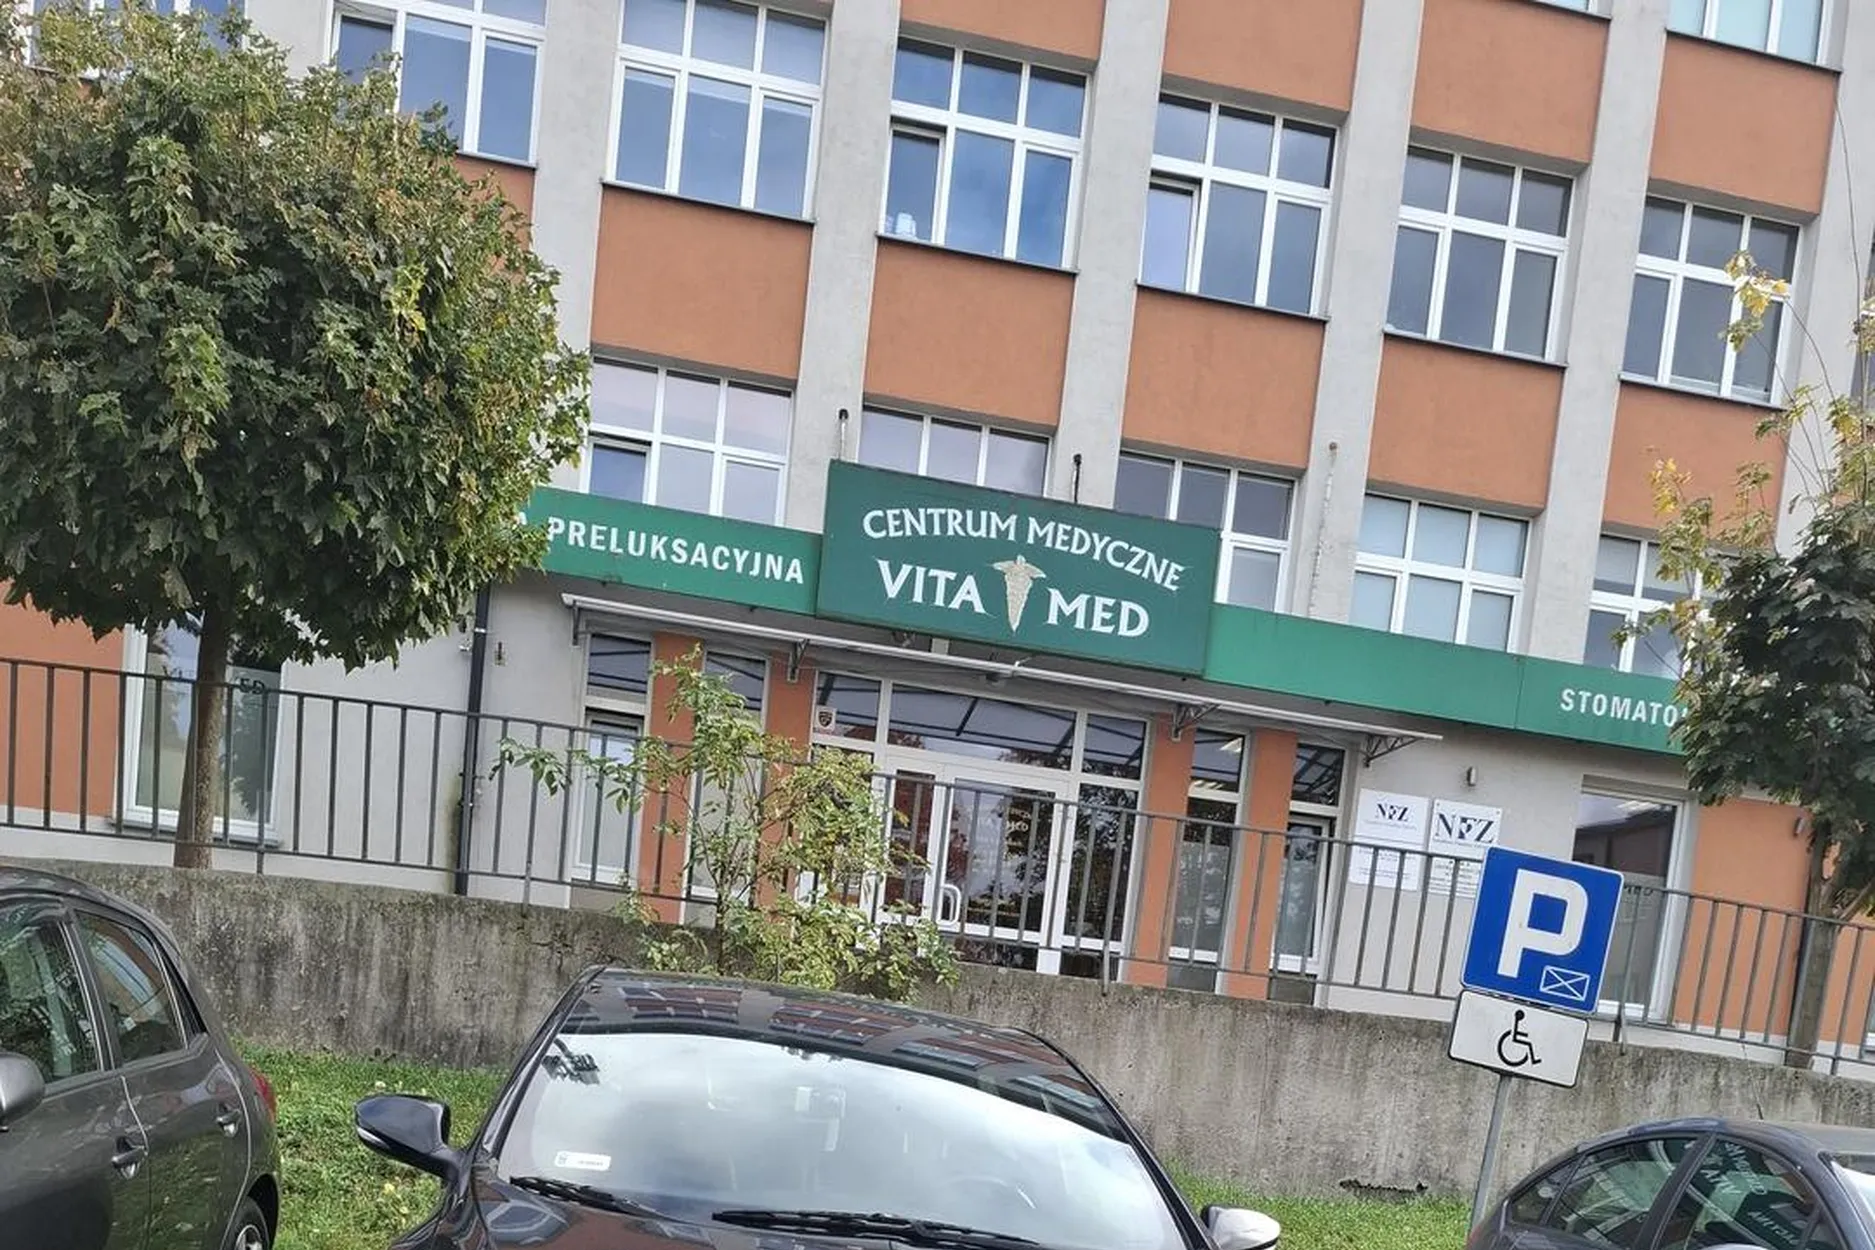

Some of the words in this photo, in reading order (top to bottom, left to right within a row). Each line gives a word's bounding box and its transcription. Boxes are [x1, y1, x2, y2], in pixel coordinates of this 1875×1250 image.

[547, 516, 804, 584] PRELUKSACYJNA
[862, 508, 1018, 542] CENTRUM
[1026, 516, 1188, 591] MEDYCZNE
[873, 556, 994, 615] VITA
[1046, 587, 1149, 637] MED
[1560, 688, 1687, 727] STOMATO
[1376, 803, 1408, 822] NFZ
[1435, 813, 1494, 844] NFZ
[1497, 868, 1588, 978] P
